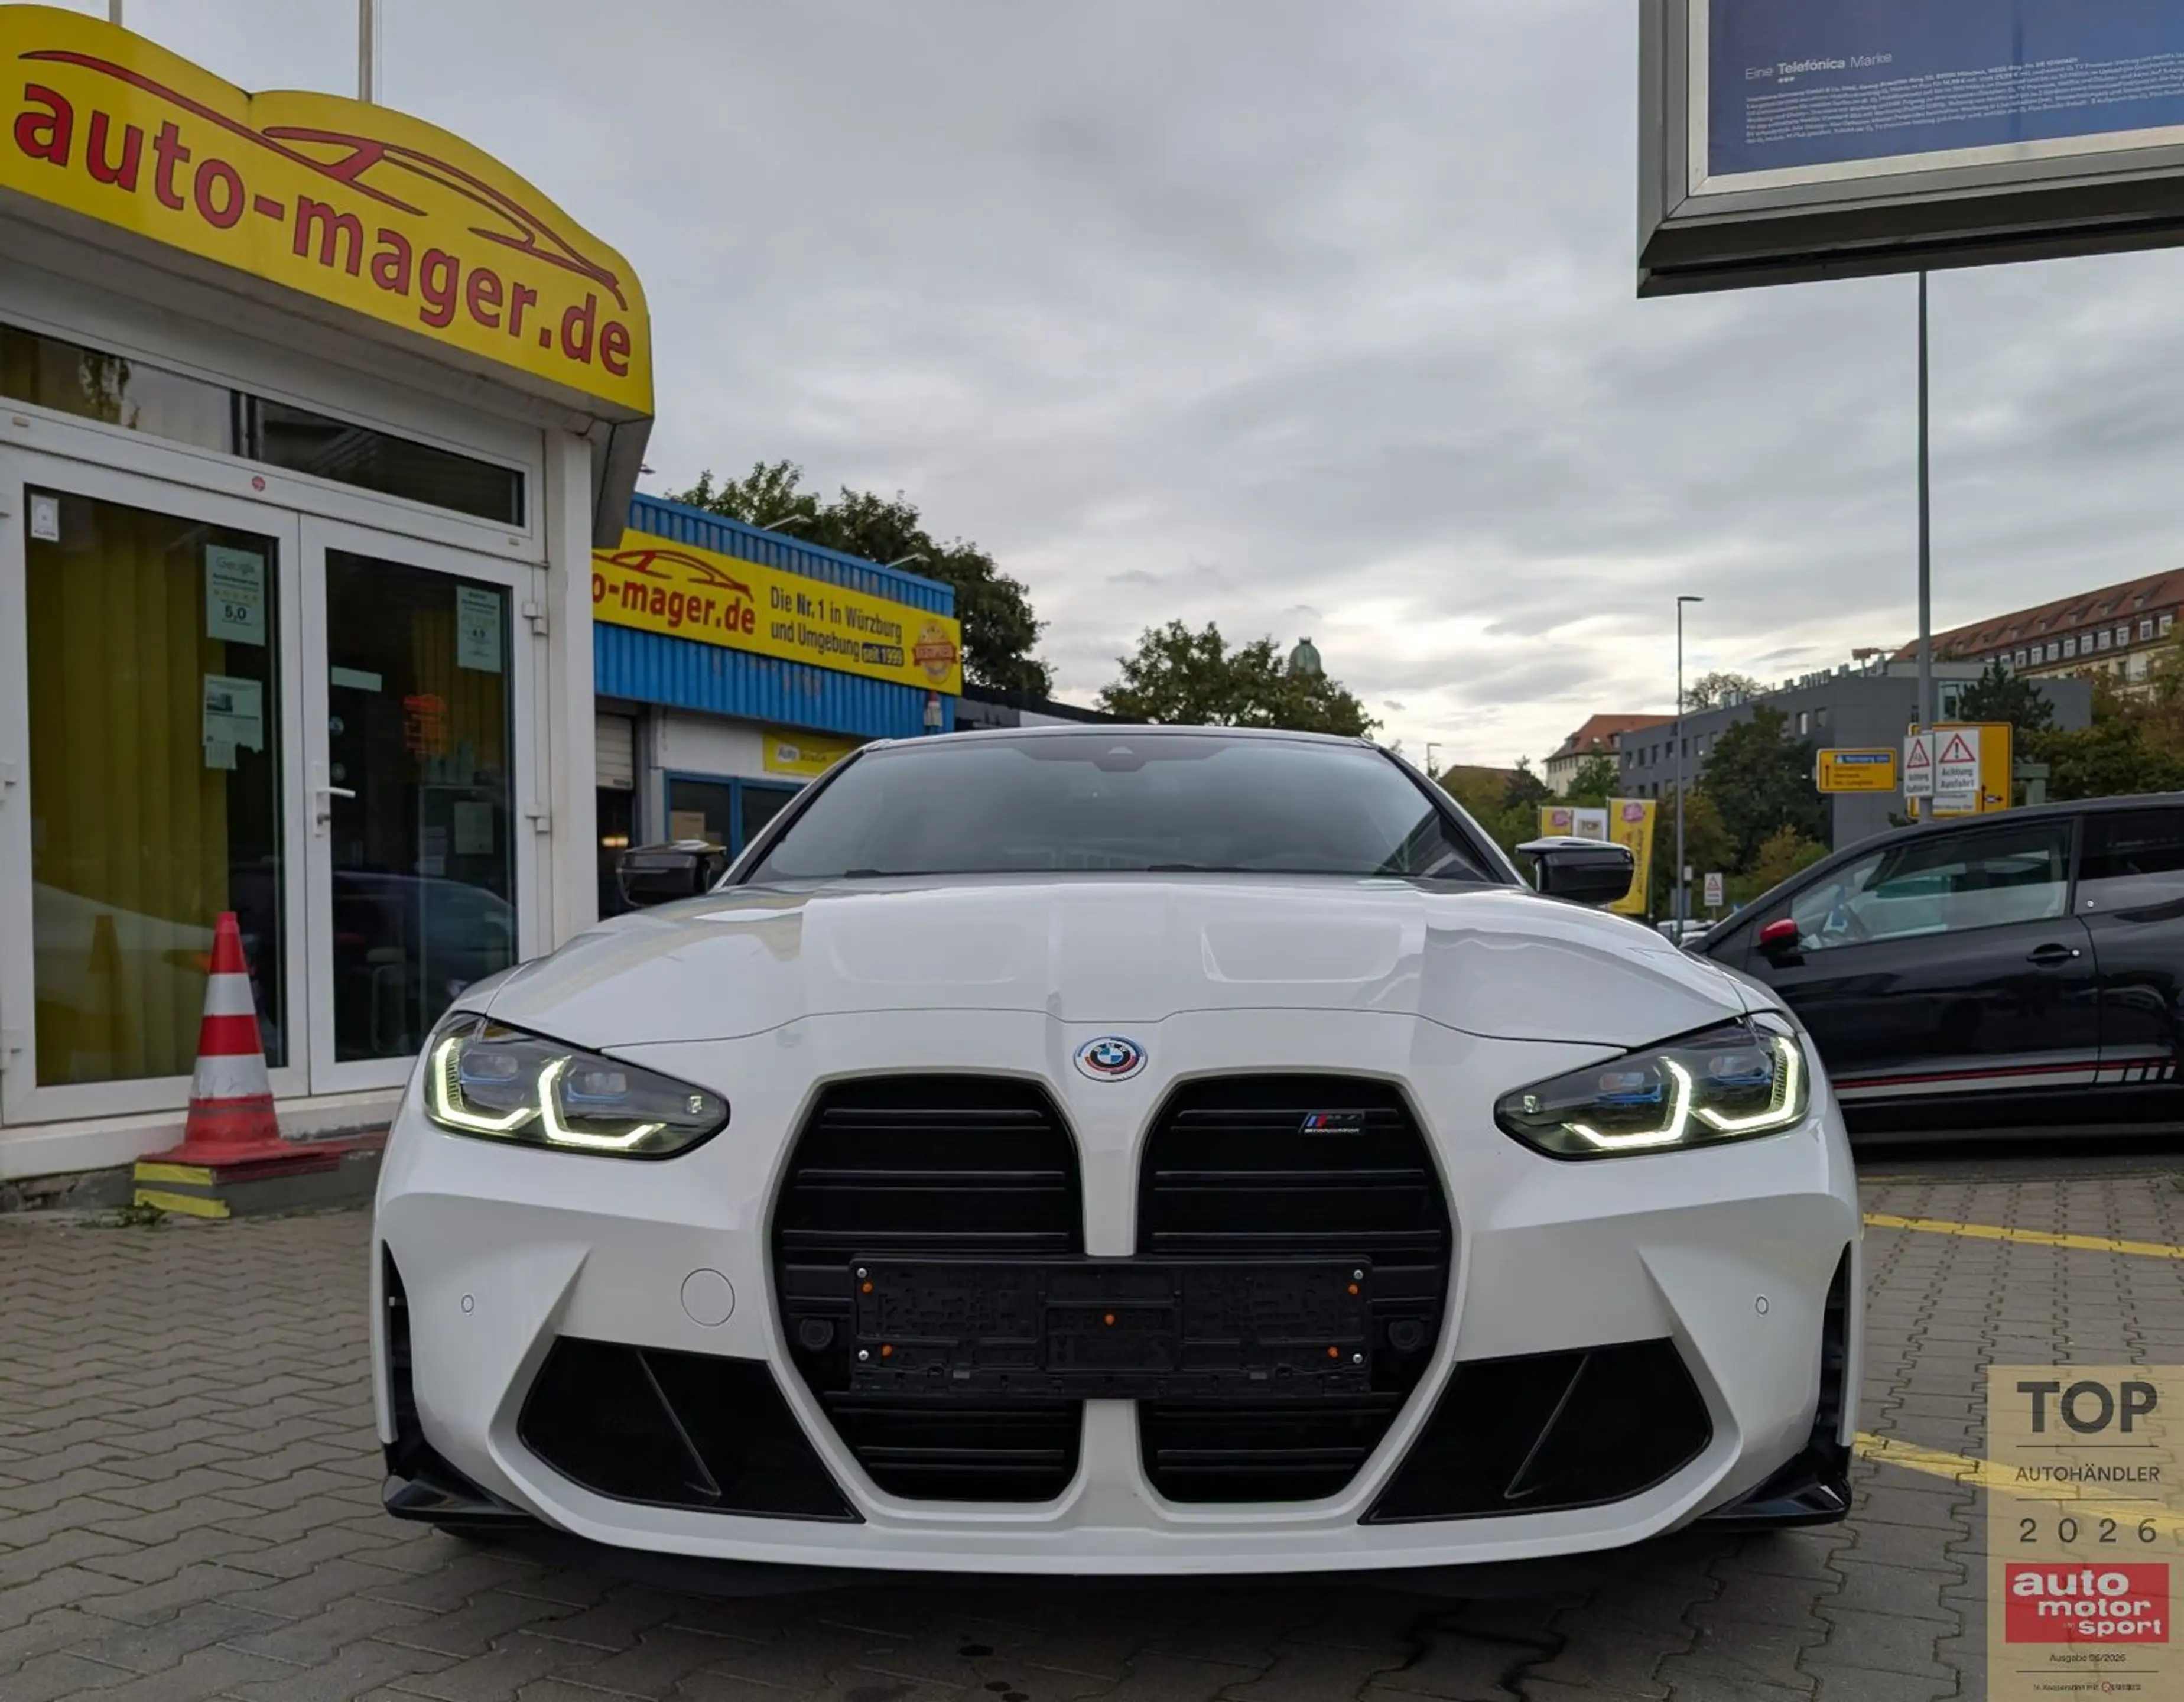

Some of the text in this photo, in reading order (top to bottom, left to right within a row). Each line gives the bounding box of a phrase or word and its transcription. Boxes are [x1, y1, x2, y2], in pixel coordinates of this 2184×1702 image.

[1745, 51, 1894, 80] Eine Telefónica Marke
[14, 83, 631, 377] auto-mager.de
[771, 585, 902, 644] Die Nr. 1 in Würzburg
[771, 619, 793, 642] und
[798, 622, 860, 663] Umgebung
